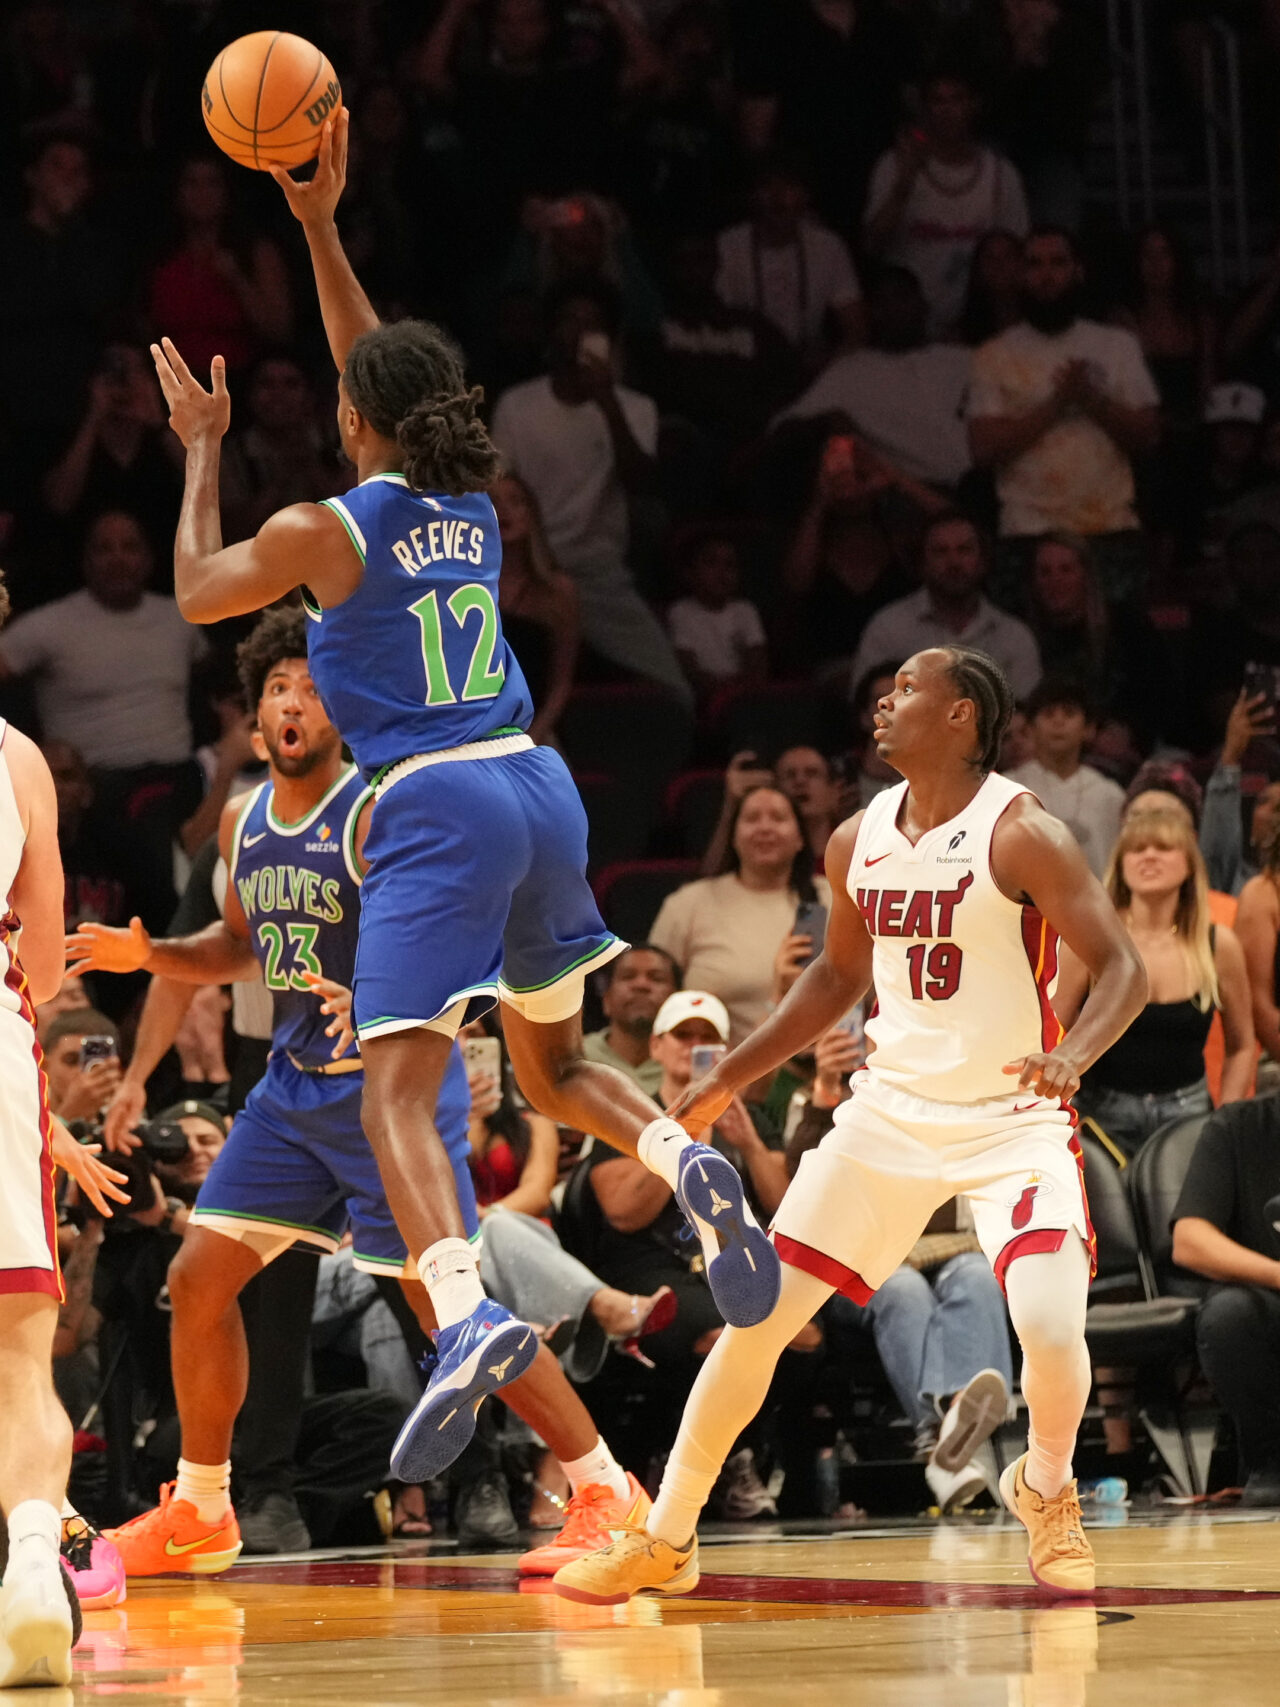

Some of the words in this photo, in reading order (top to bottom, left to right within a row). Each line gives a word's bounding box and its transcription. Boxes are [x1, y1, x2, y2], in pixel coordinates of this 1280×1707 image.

[391, 520, 484, 577] REEVES
[406, 583, 505, 706] 12
[305, 841, 339, 853] sezzle
[936, 856, 972, 864] Robinhood
[237, 865, 343, 923] WOLVES
[856, 870, 974, 938] HEAT
[257, 922, 322, 991] 23
[906, 943, 963, 1001] 19
